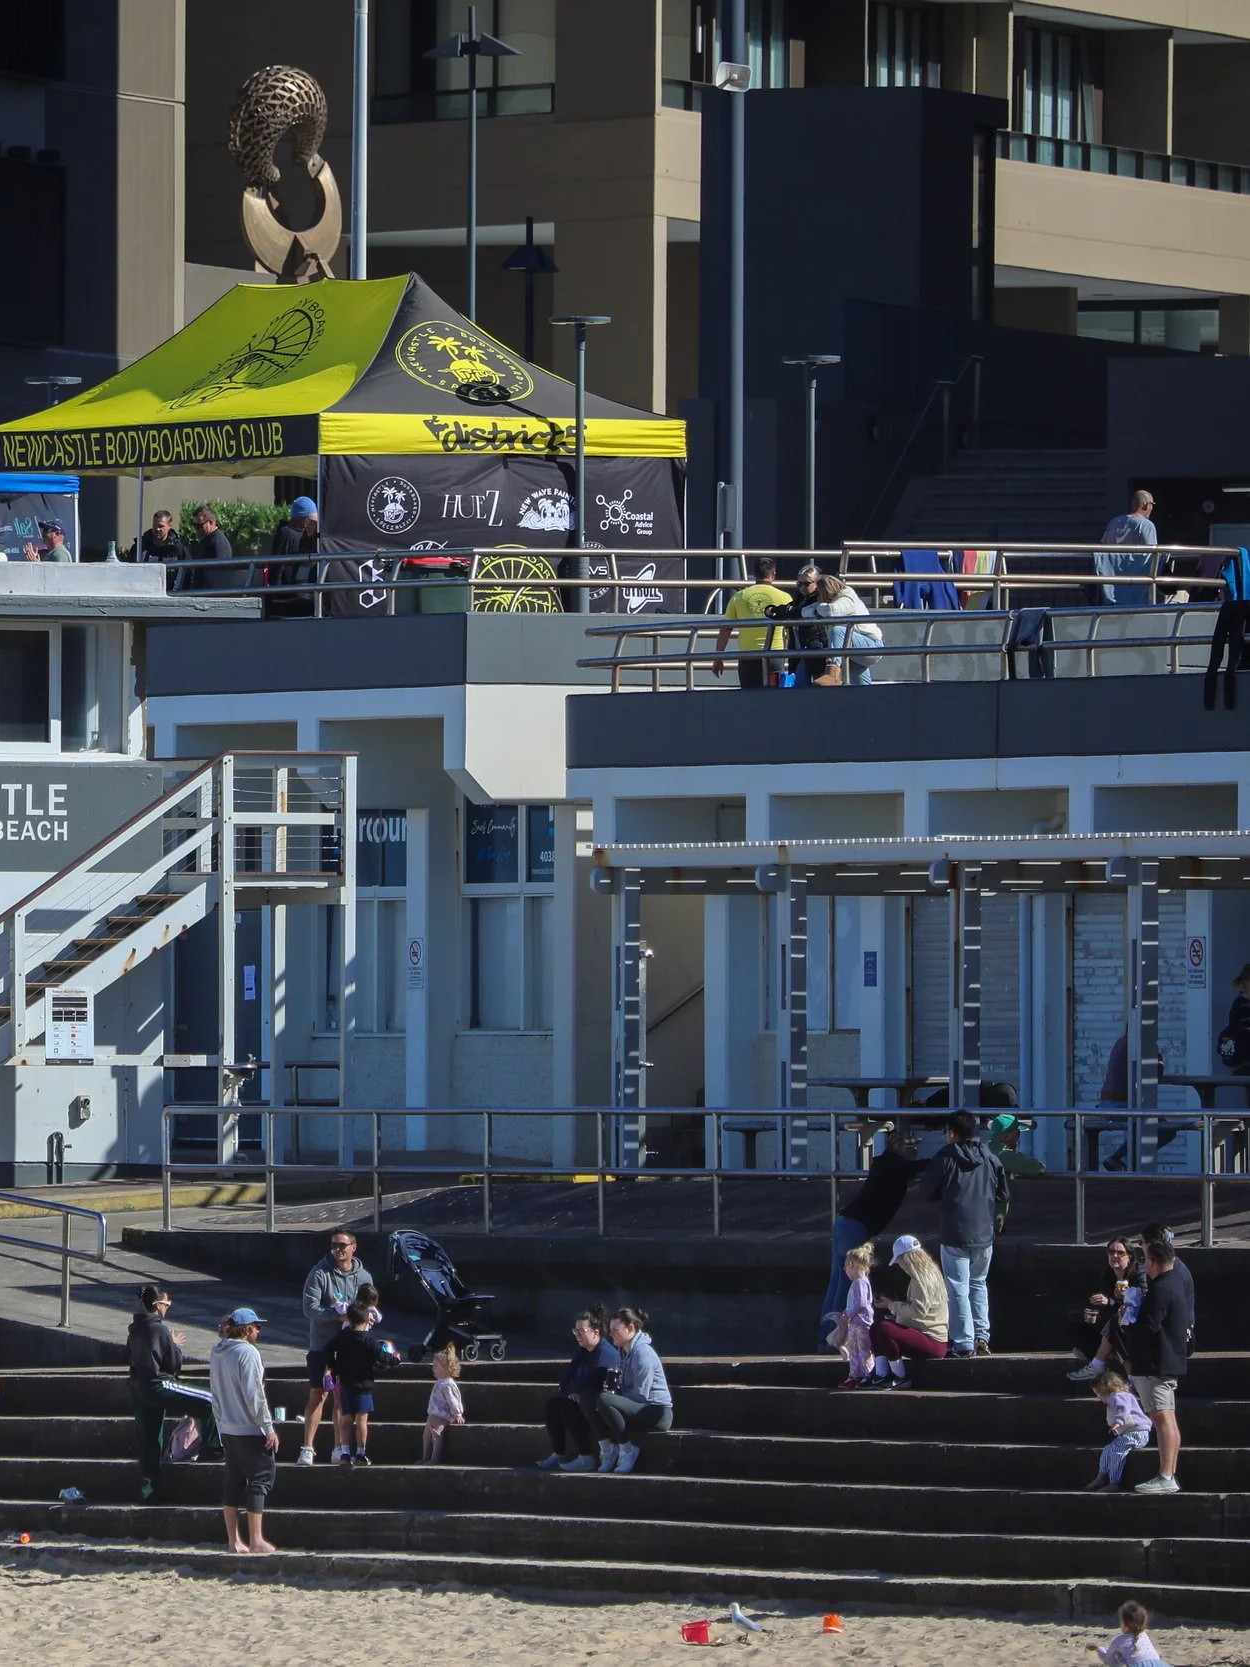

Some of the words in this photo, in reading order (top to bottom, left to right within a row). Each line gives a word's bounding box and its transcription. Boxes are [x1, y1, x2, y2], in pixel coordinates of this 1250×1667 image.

[2, 432, 103, 468] NEWCASTLE
[105, 424, 237, 465] BODYBOARDING
[239, 421, 284, 457] CLUB
[441, 489, 503, 527] HUEZ
[518, 497, 531, 516] NEW
[531, 488, 552, 500] WAVE
[625, 511, 654, 521] Coastal
[636, 528, 653, 536] Group
